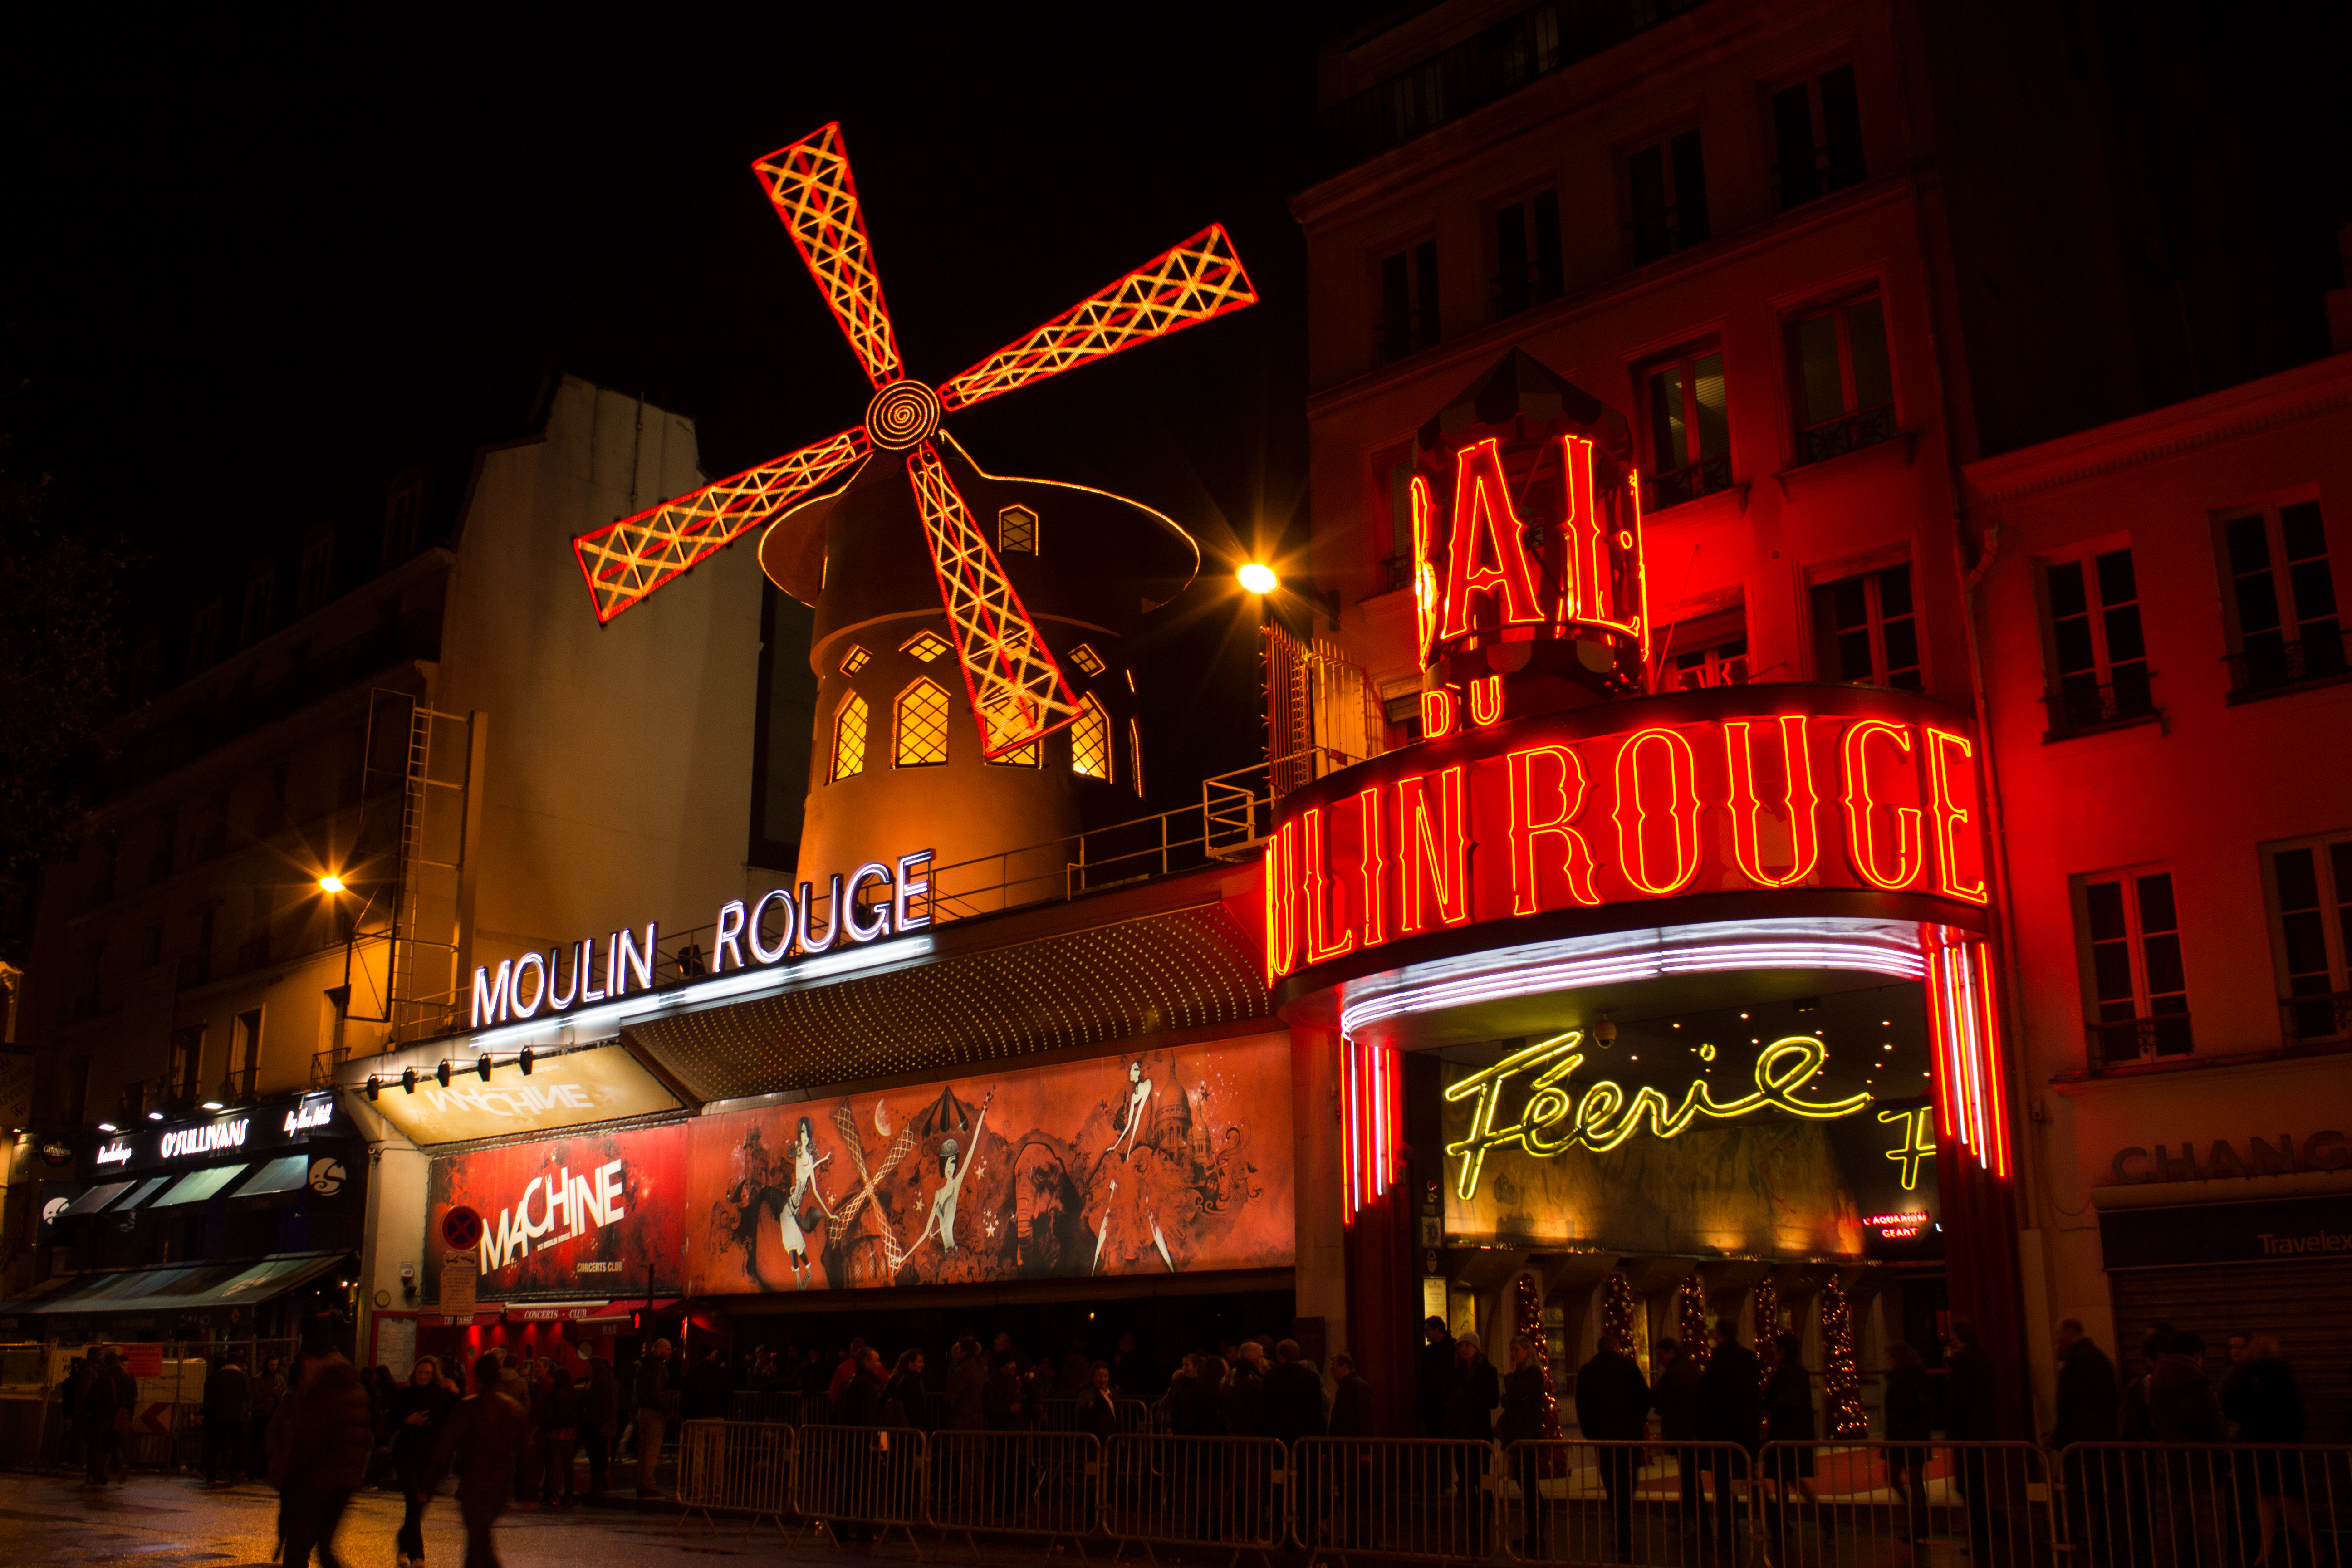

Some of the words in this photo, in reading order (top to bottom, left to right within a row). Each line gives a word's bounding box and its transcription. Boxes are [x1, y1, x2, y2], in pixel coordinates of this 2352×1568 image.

[1421, 675, 1501, 738] DU
[1507, 714, 1987, 916] ROUGE
[472, 921, 658, 1027] MOULIN
[712, 848, 936, 973] ROUGE
[1444, 1030, 1874, 1201] Féerie
[44, 1145, 71, 1156] GUINNESS
[161, 1118, 250, 1158] O'SULLIVANS
[2112, 1130, 2347, 1184] CHANG
[480, 1158, 624, 1276] MACHINE
[1882, 1226, 1918, 1238] GEANT
[2257, 1230, 2352, 1254] Travelex
[577, 1261, 607, 1273] CONCERTS
[608, 1261, 623, 1272] CLUB
[524, 1310, 559, 1320] CONCERTS
[569, 1309, 587, 1319] CLUB
[603, 1324, 617, 1335] BAR
